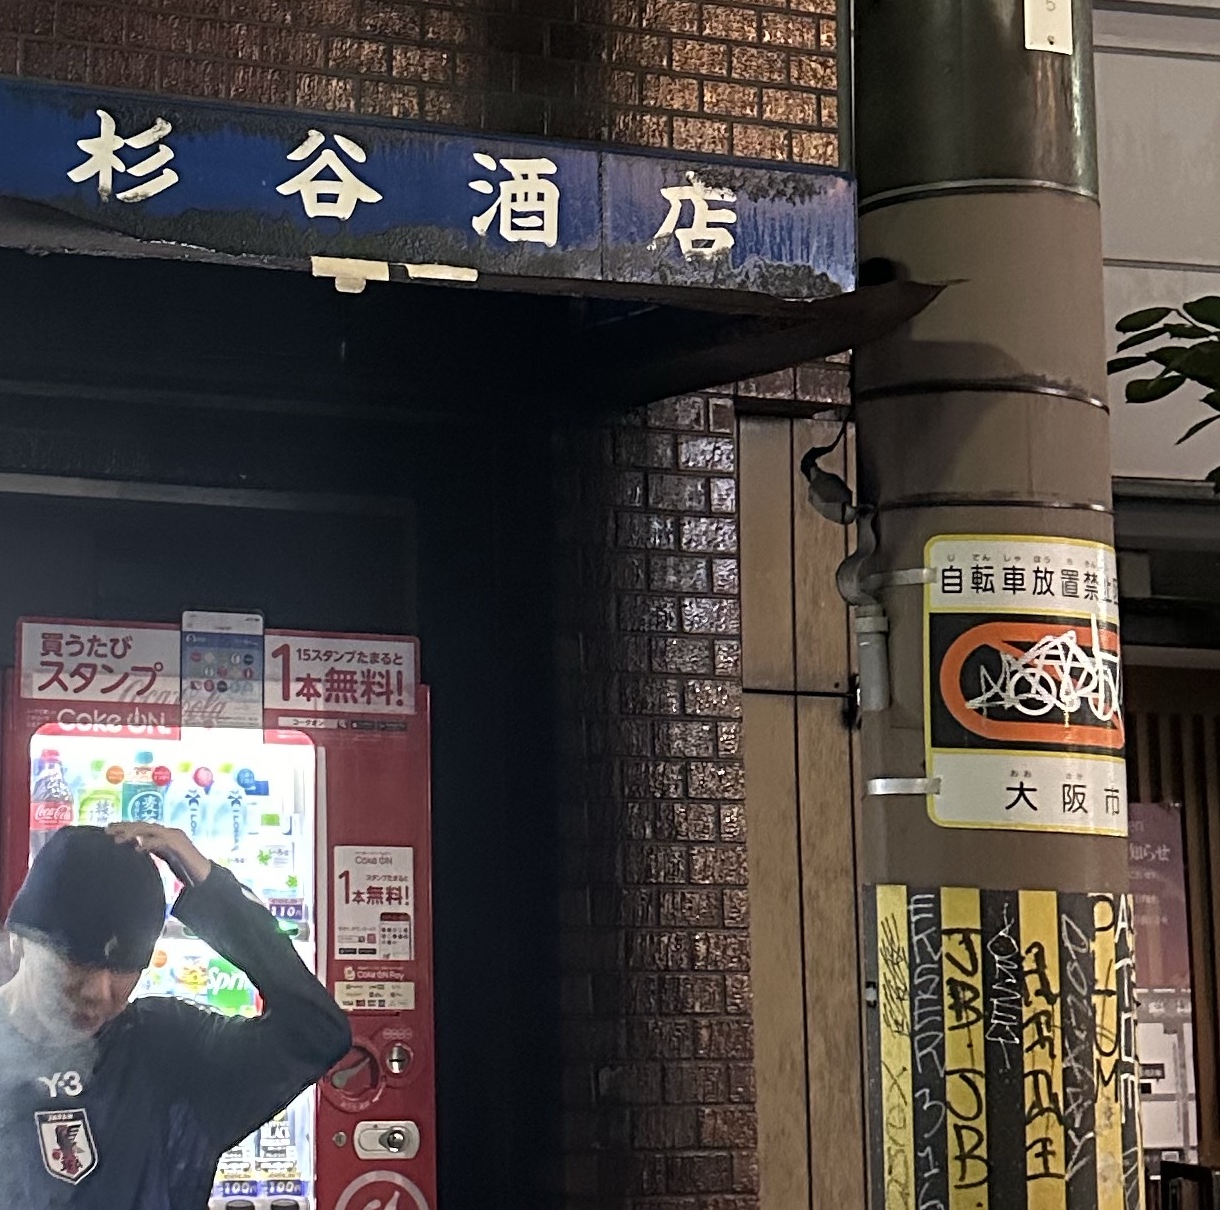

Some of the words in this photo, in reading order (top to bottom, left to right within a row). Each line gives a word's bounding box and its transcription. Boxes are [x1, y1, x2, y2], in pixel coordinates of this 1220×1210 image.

[67, 108, 738, 262] 杉谷酒店
[42, 633, 133, 659] 買うたび
[296, 648, 403, 666] 15スタンプたまると
[38, 661, 164, 696] スタンプ
[272, 643, 404, 706] 1本無料!
[62, 707, 128, 732] Coke
[1005, 781, 1121, 816] 大阪市
[338, 870, 409, 906] 1本無料!
[37, 1070, 84, 1098] Y-3
